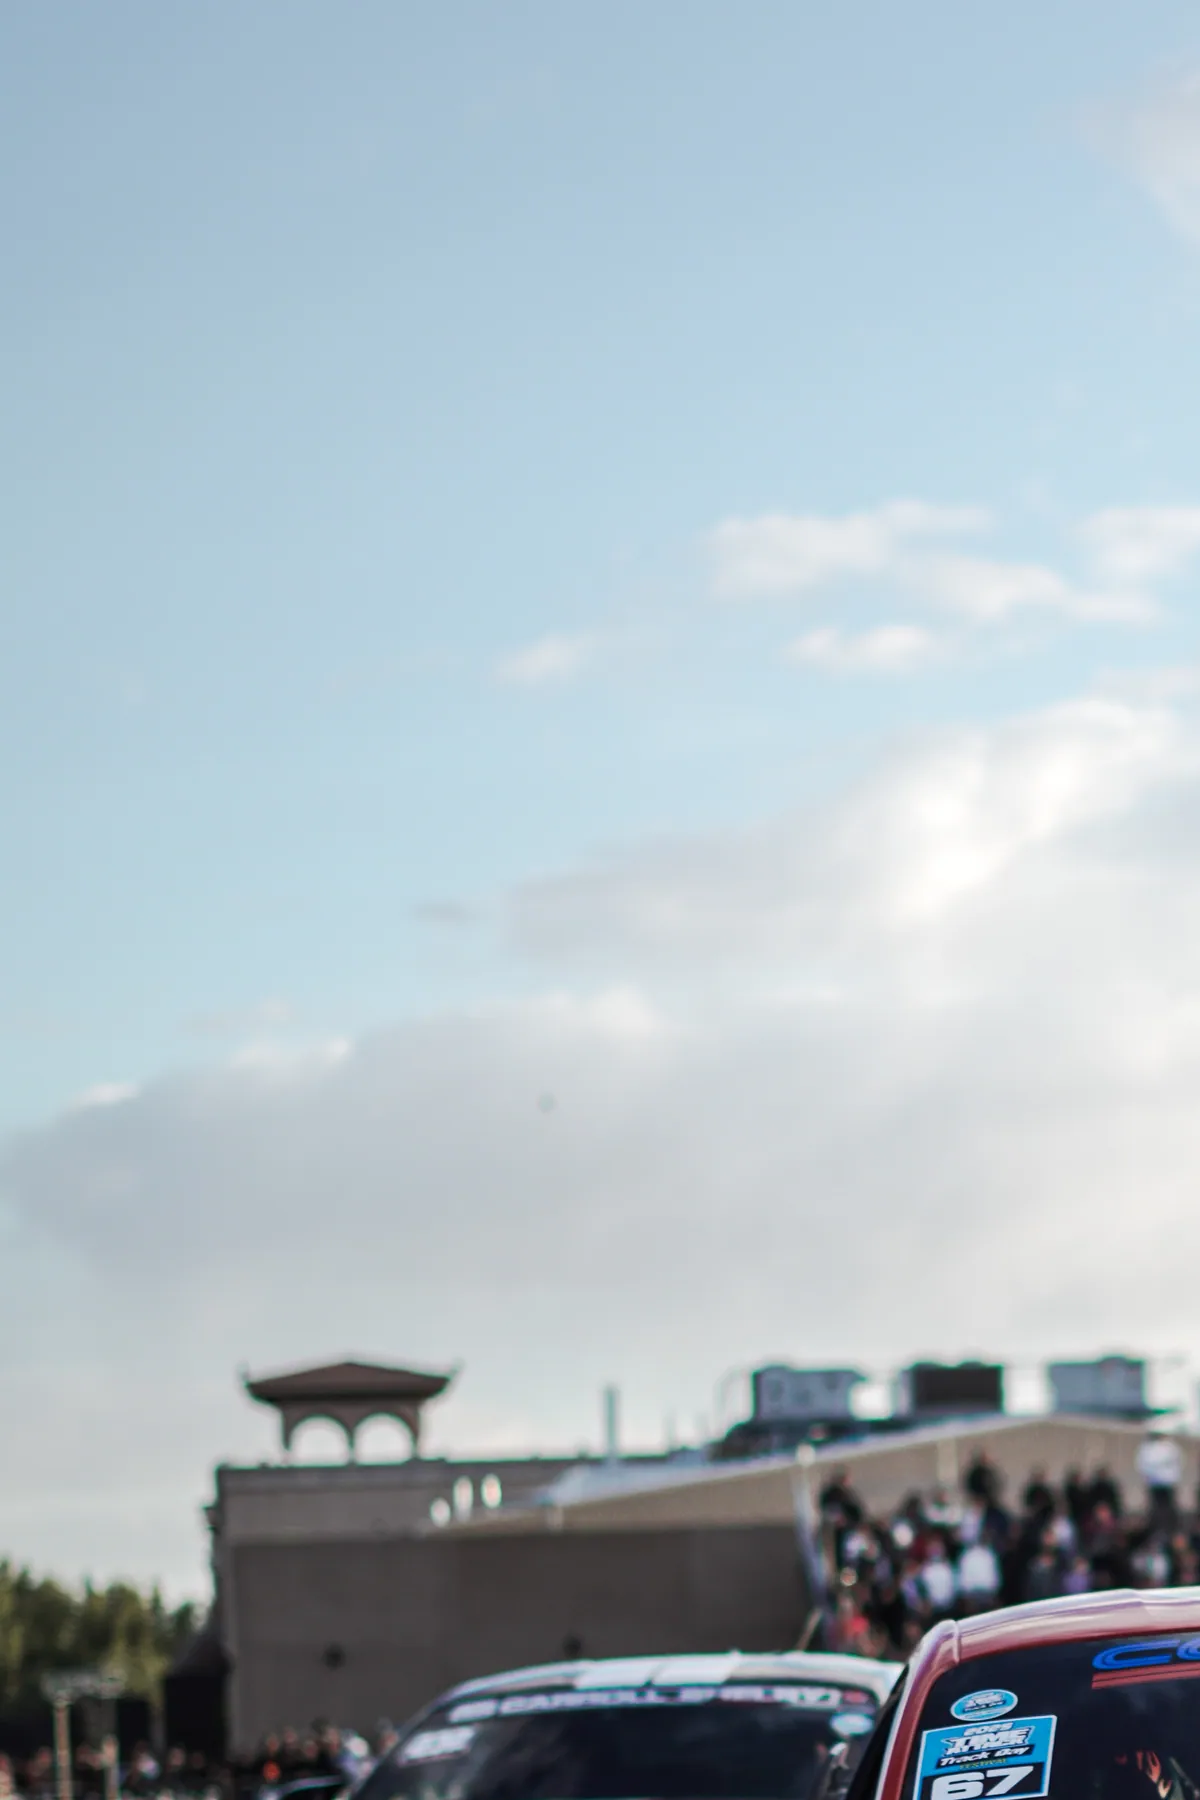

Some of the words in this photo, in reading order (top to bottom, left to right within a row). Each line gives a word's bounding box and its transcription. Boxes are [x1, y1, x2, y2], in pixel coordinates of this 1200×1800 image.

[949, 1728, 1030, 1749] TIME
[940, 1751, 991, 1766] Track
[994, 1746, 1030, 1757] Day
